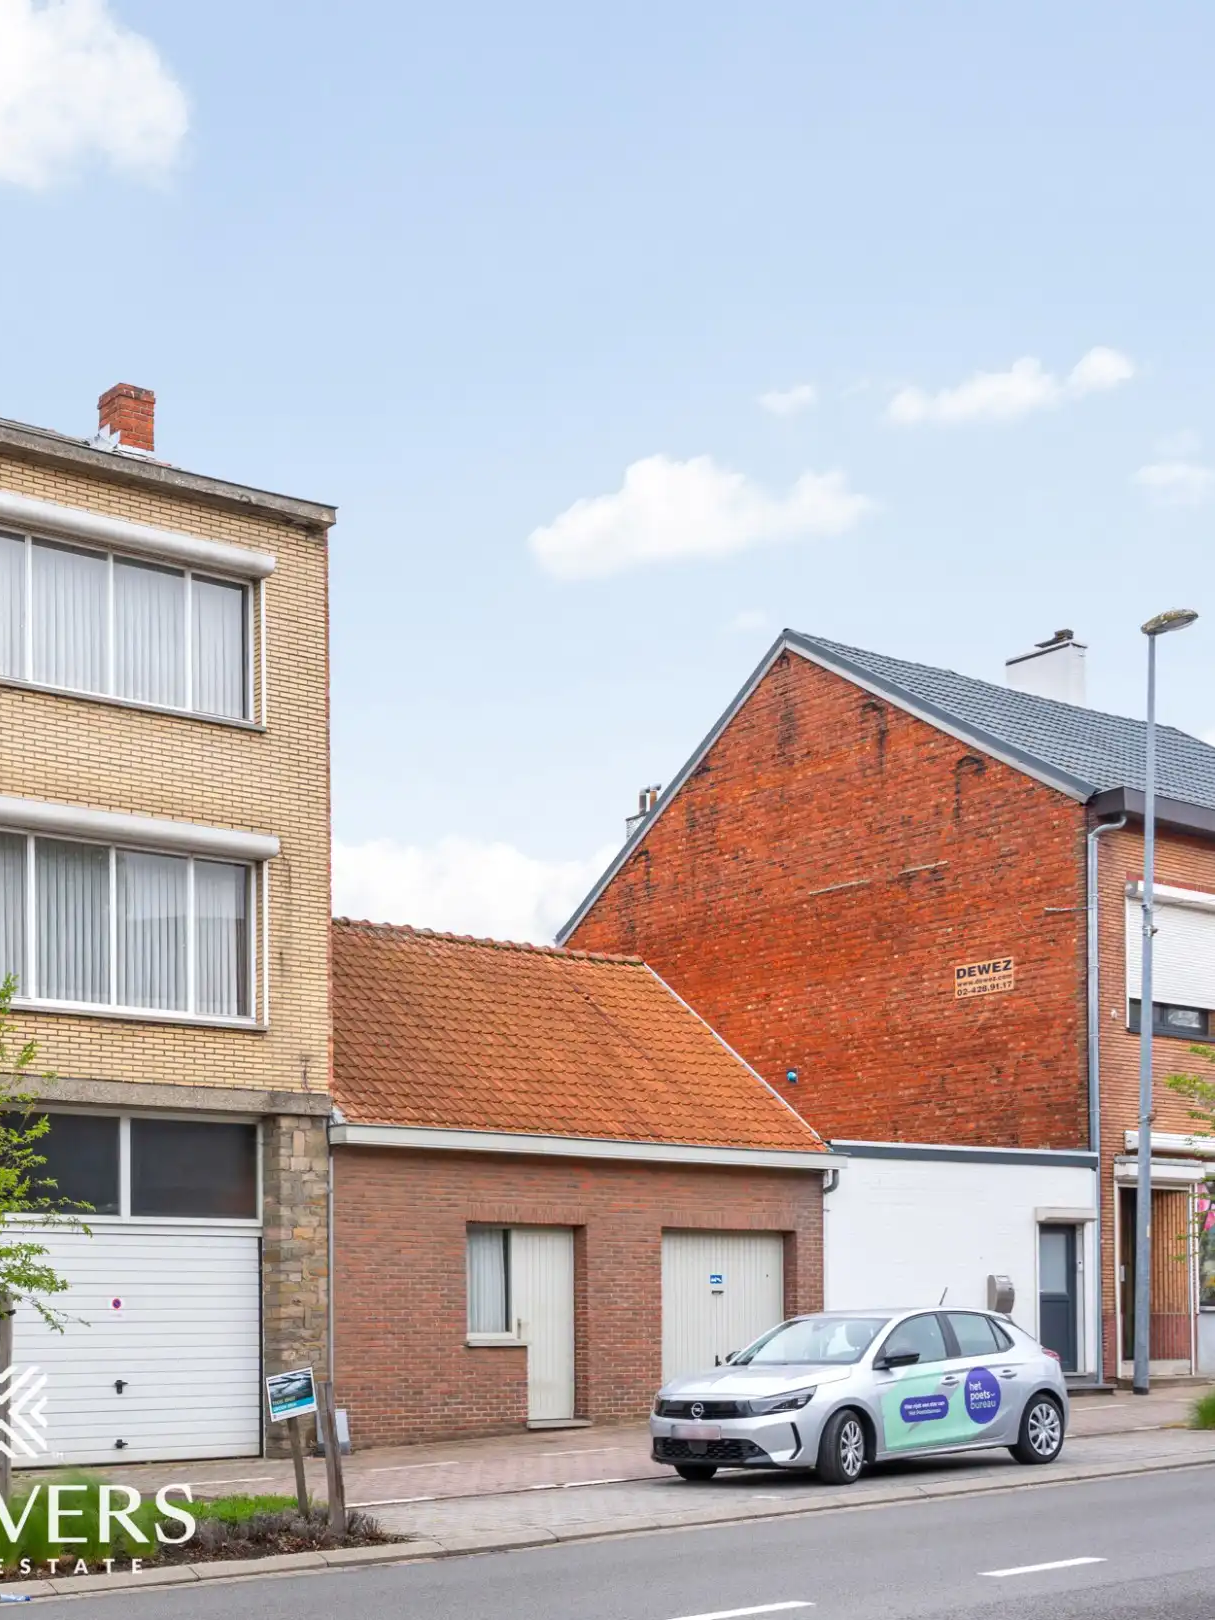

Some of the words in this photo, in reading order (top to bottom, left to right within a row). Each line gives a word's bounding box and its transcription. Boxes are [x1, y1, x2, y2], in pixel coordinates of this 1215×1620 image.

[956, 959, 1012, 980] DEWEZ
[969, 1381, 982, 1391] het
[970, 1400, 997, 1410] bureau
